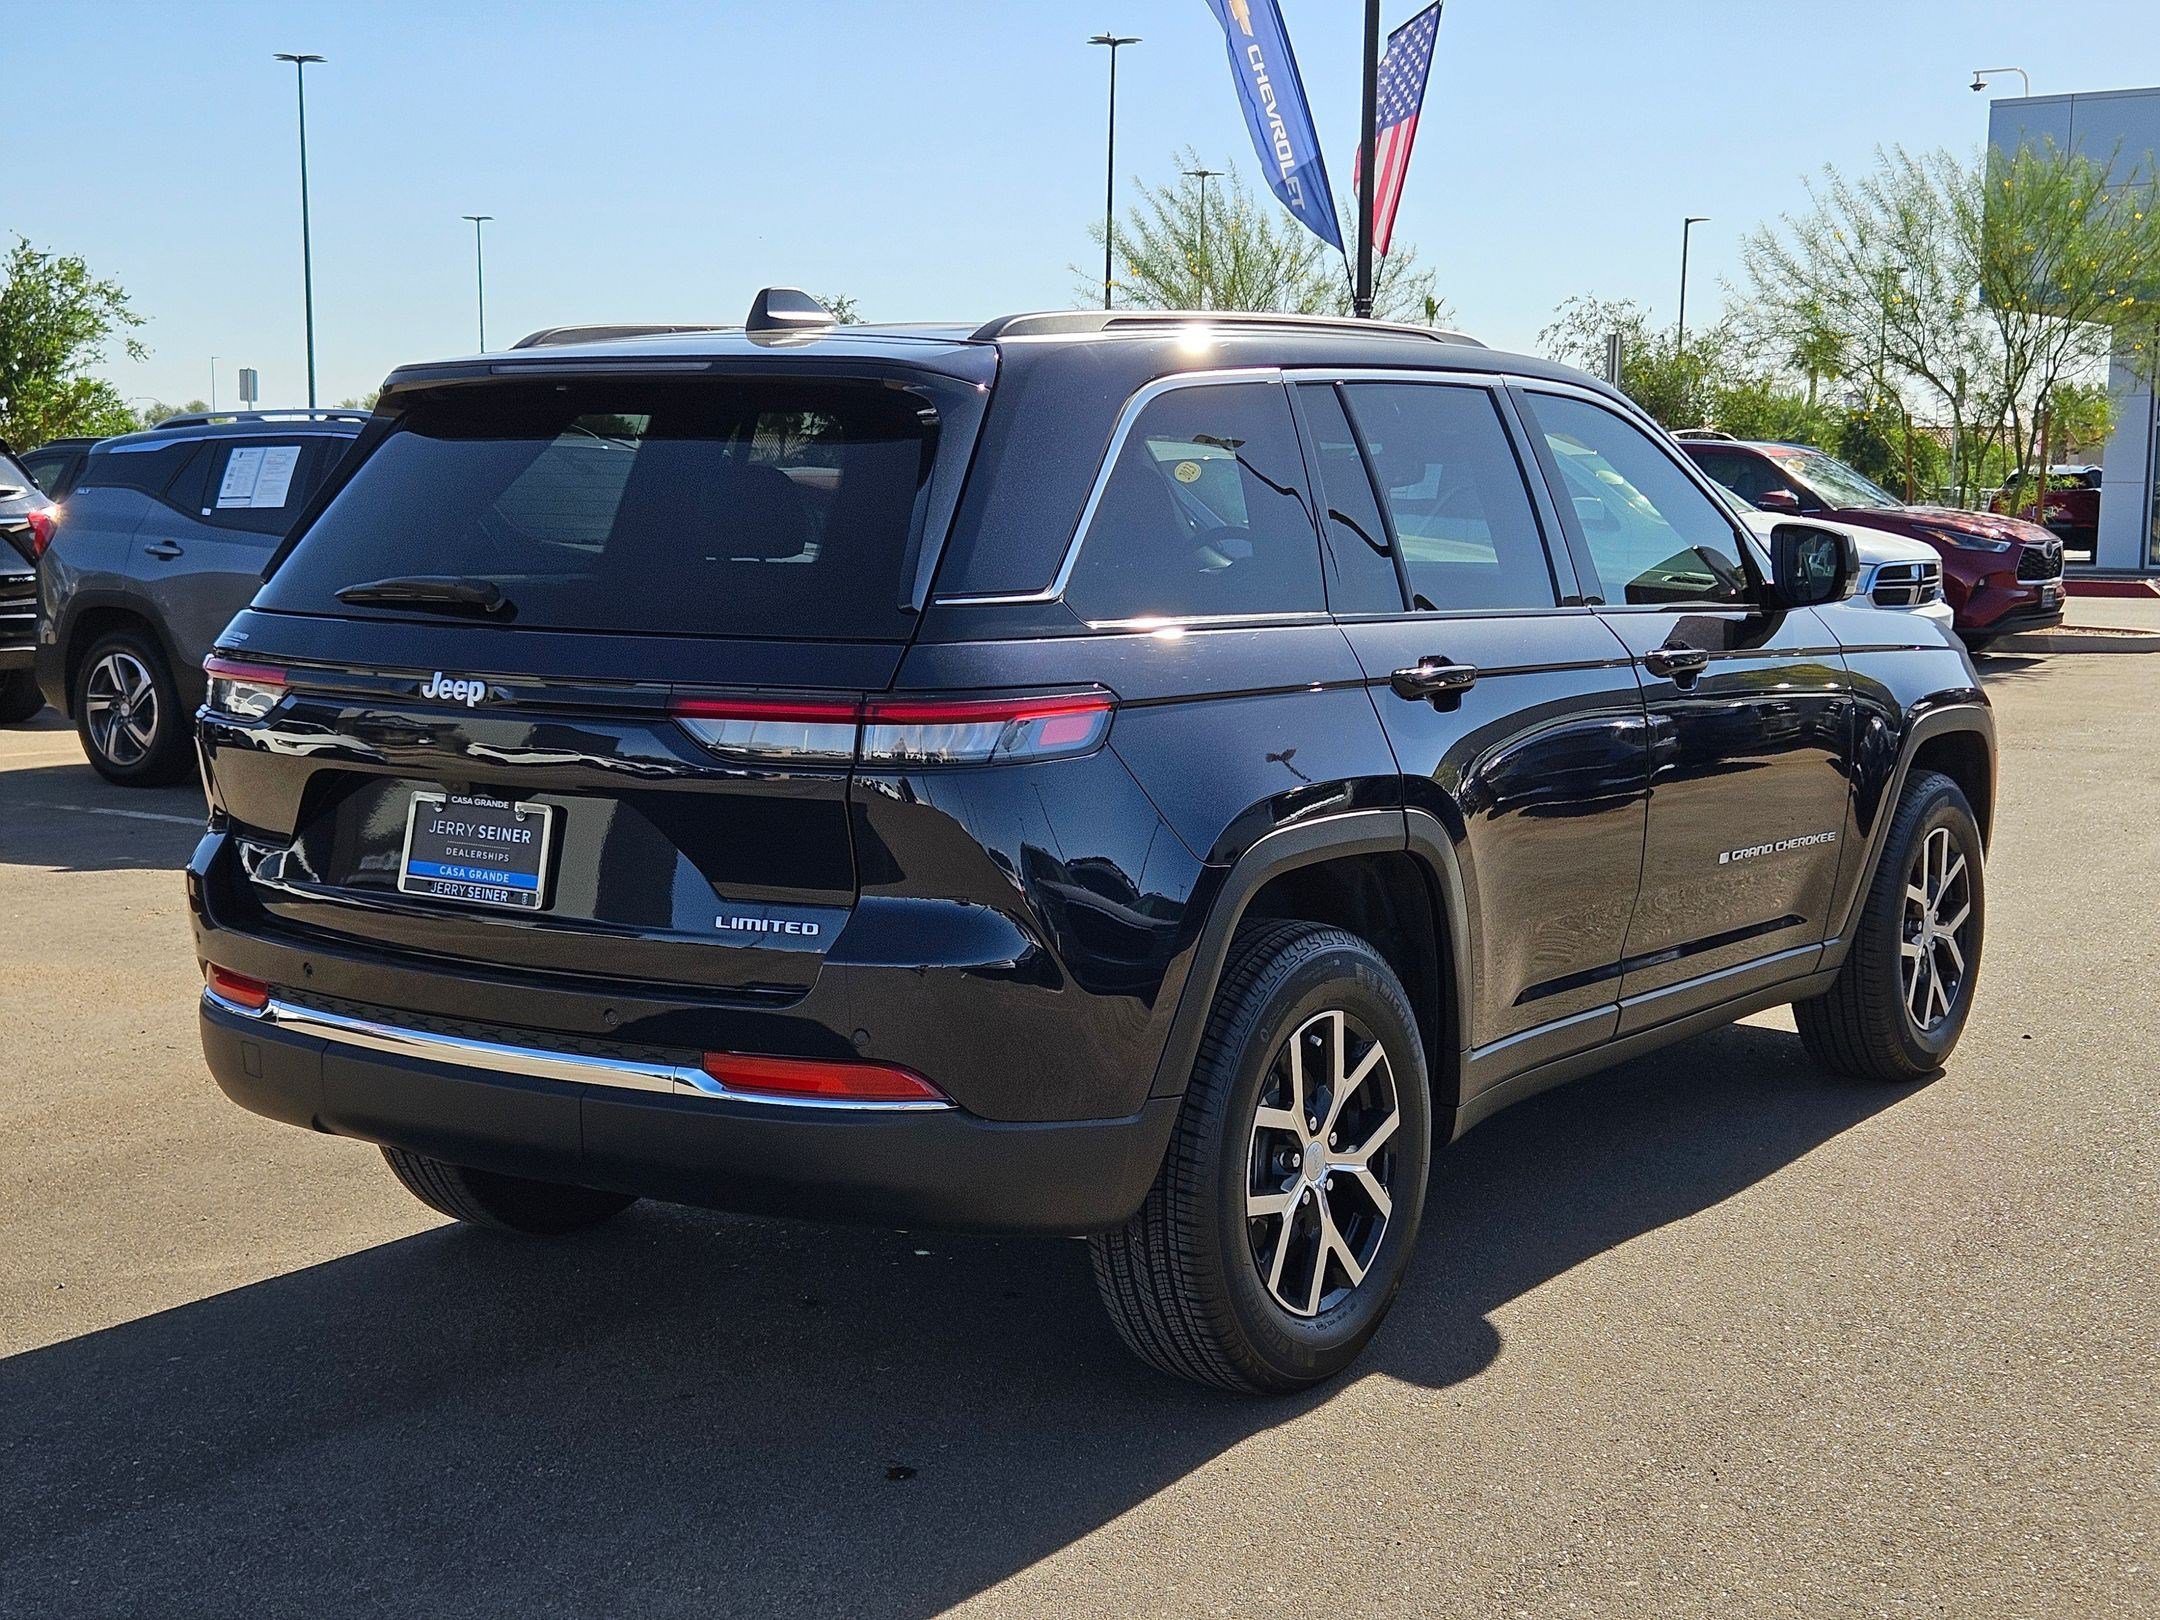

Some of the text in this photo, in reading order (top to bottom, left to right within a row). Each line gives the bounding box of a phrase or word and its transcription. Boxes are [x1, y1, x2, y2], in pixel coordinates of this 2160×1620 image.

[1247, 44, 1306, 212] CHEVROLET
[422, 671, 486, 708] Jeep
[451, 795, 510, 809] CASA GRANDE
[428, 819, 532, 844] JERRY SEINER
[446, 847, 510, 862] DEALERSHIPS
[1731, 831, 1837, 861] GRAND CHEROKEE
[439, 865, 510, 883] CASA GRANDE
[430, 882, 466, 897] JERRY
[467, 886, 509, 902] SEINER
[715, 916, 819, 935] LIMITED
